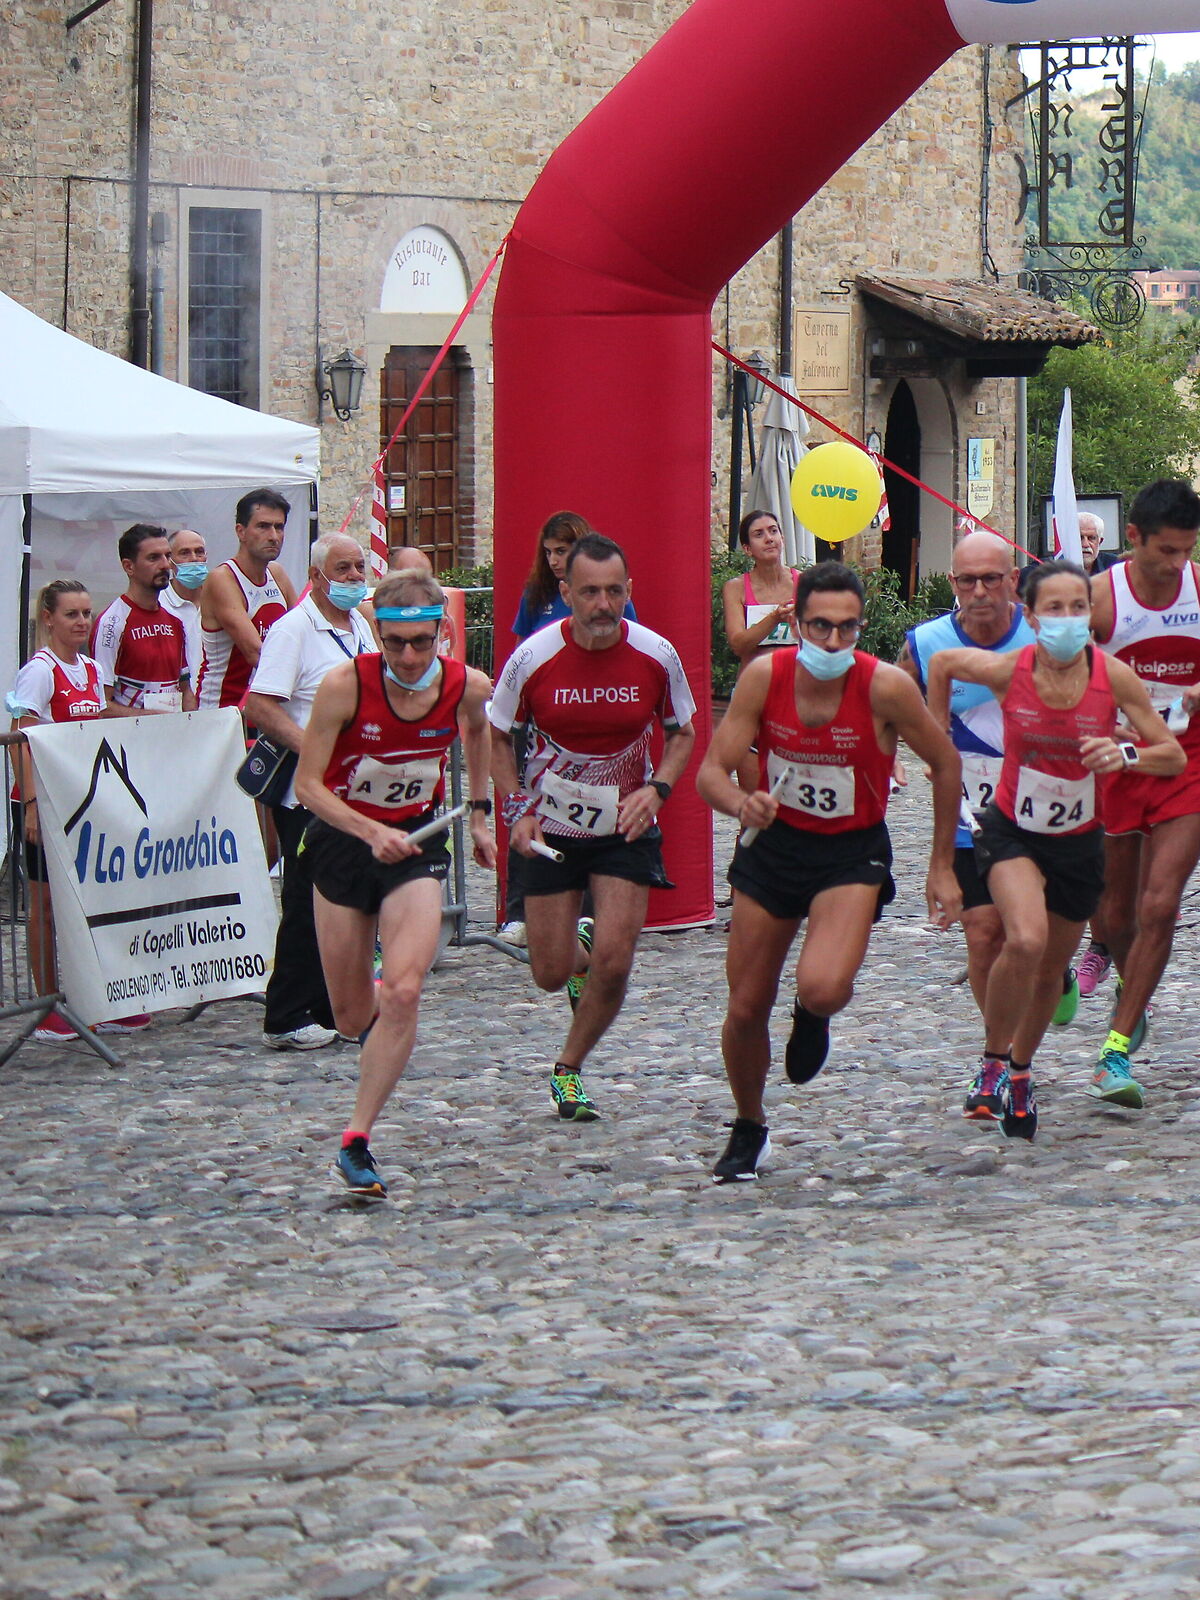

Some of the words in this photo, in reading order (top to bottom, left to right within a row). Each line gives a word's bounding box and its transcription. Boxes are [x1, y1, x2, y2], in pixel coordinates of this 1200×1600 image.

[394, 239, 448, 270] Ristorante
[412, 269, 431, 286] Bar
[804, 315, 839, 337] Taverna
[815, 341, 828, 357] del
[801, 359, 841, 384] Falconiere
[811, 484, 858, 501] AVIS
[131, 623, 175, 641] ITALPOSE
[554, 686, 640, 705] ITALPOSE
[357, 780, 372, 794] A
[384, 779, 423, 803] 26
[798, 783, 837, 812] 33
[978, 782, 993, 809] 2
[546, 794, 559, 809] A
[568, 803, 603, 829] 27
[1020, 796, 1034, 818] A
[1047, 800, 1084, 827] 24
[94, 832, 126, 884] La
[134, 815, 239, 880] Grondaia
[129, 935, 140, 957] di
[143, 923, 184, 959] Copelli
[187, 916, 246, 947] Valerio
[105, 974, 150, 1003] OSSOLENGO
[150, 972, 167, 998] (PC)
[171, 964, 190, 990] Tel.
